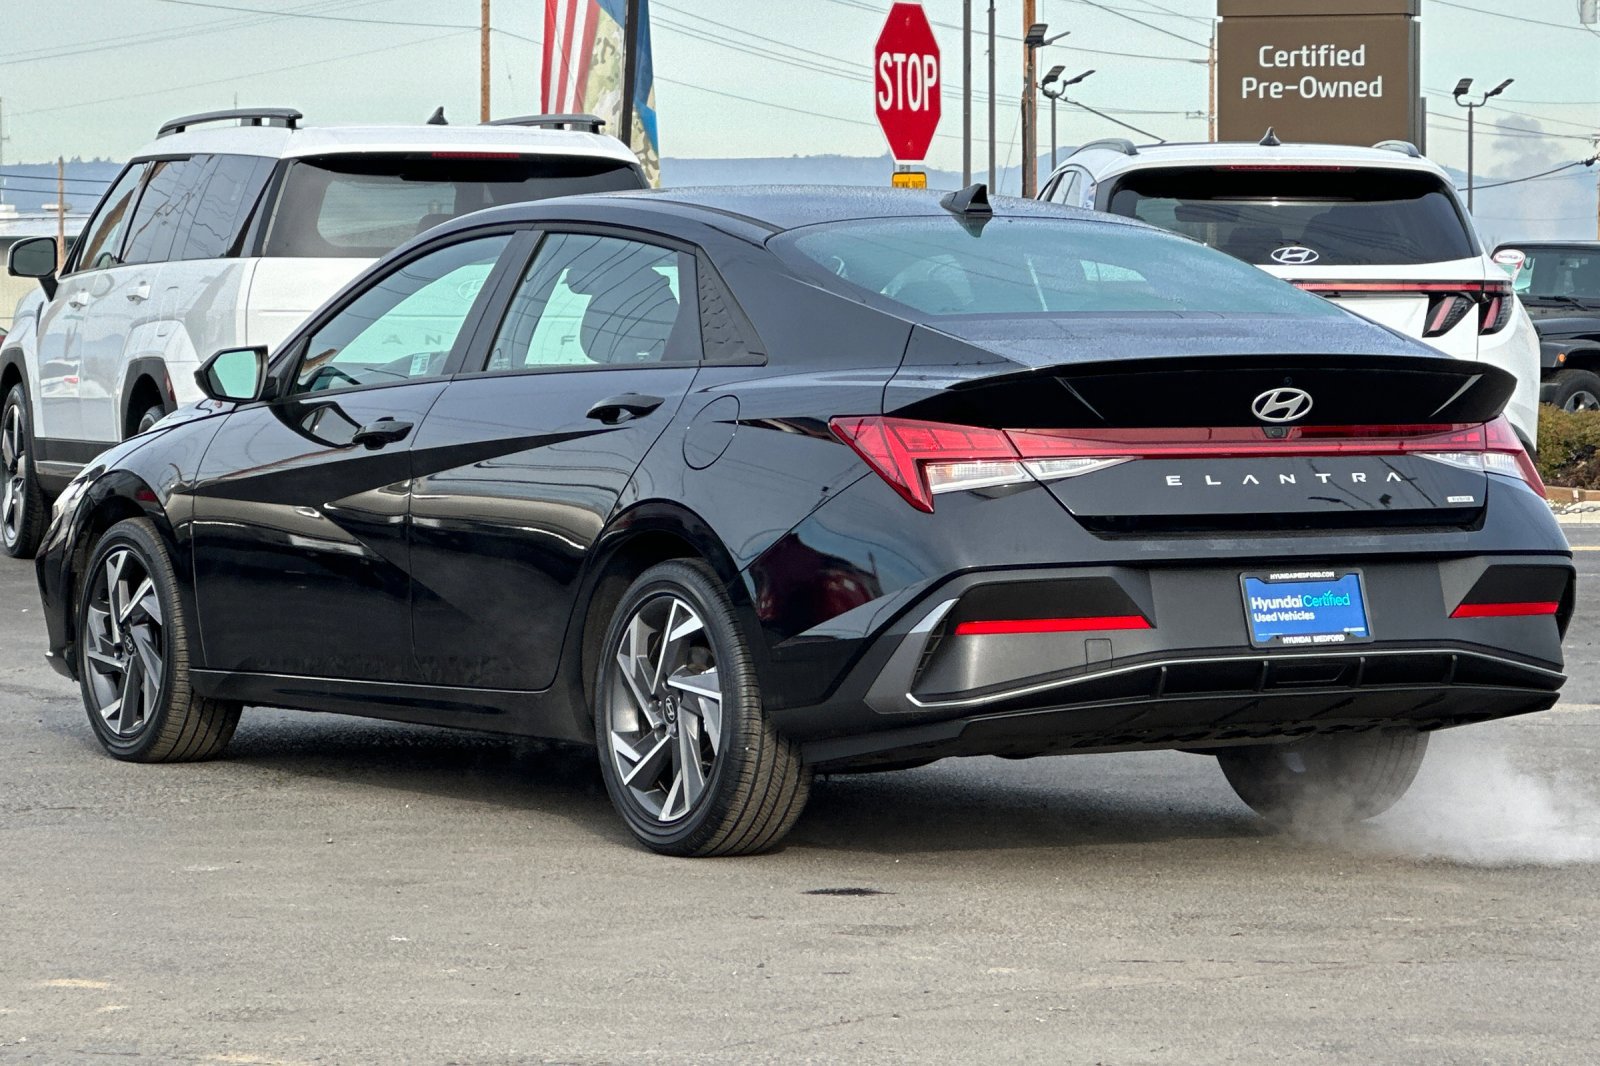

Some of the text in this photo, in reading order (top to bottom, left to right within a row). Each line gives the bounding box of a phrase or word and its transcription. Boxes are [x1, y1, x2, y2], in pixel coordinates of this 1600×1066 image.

[1259, 44, 1365, 67] Certified
[878, 52, 938, 112] STOP
[1241, 75, 1383, 99] Pre-Owned
[1165, 472, 1402, 486] ELANTRA
[1251, 591, 1351, 612] Hyundai Certified
[1254, 610, 1315, 622] Used Vehicles
